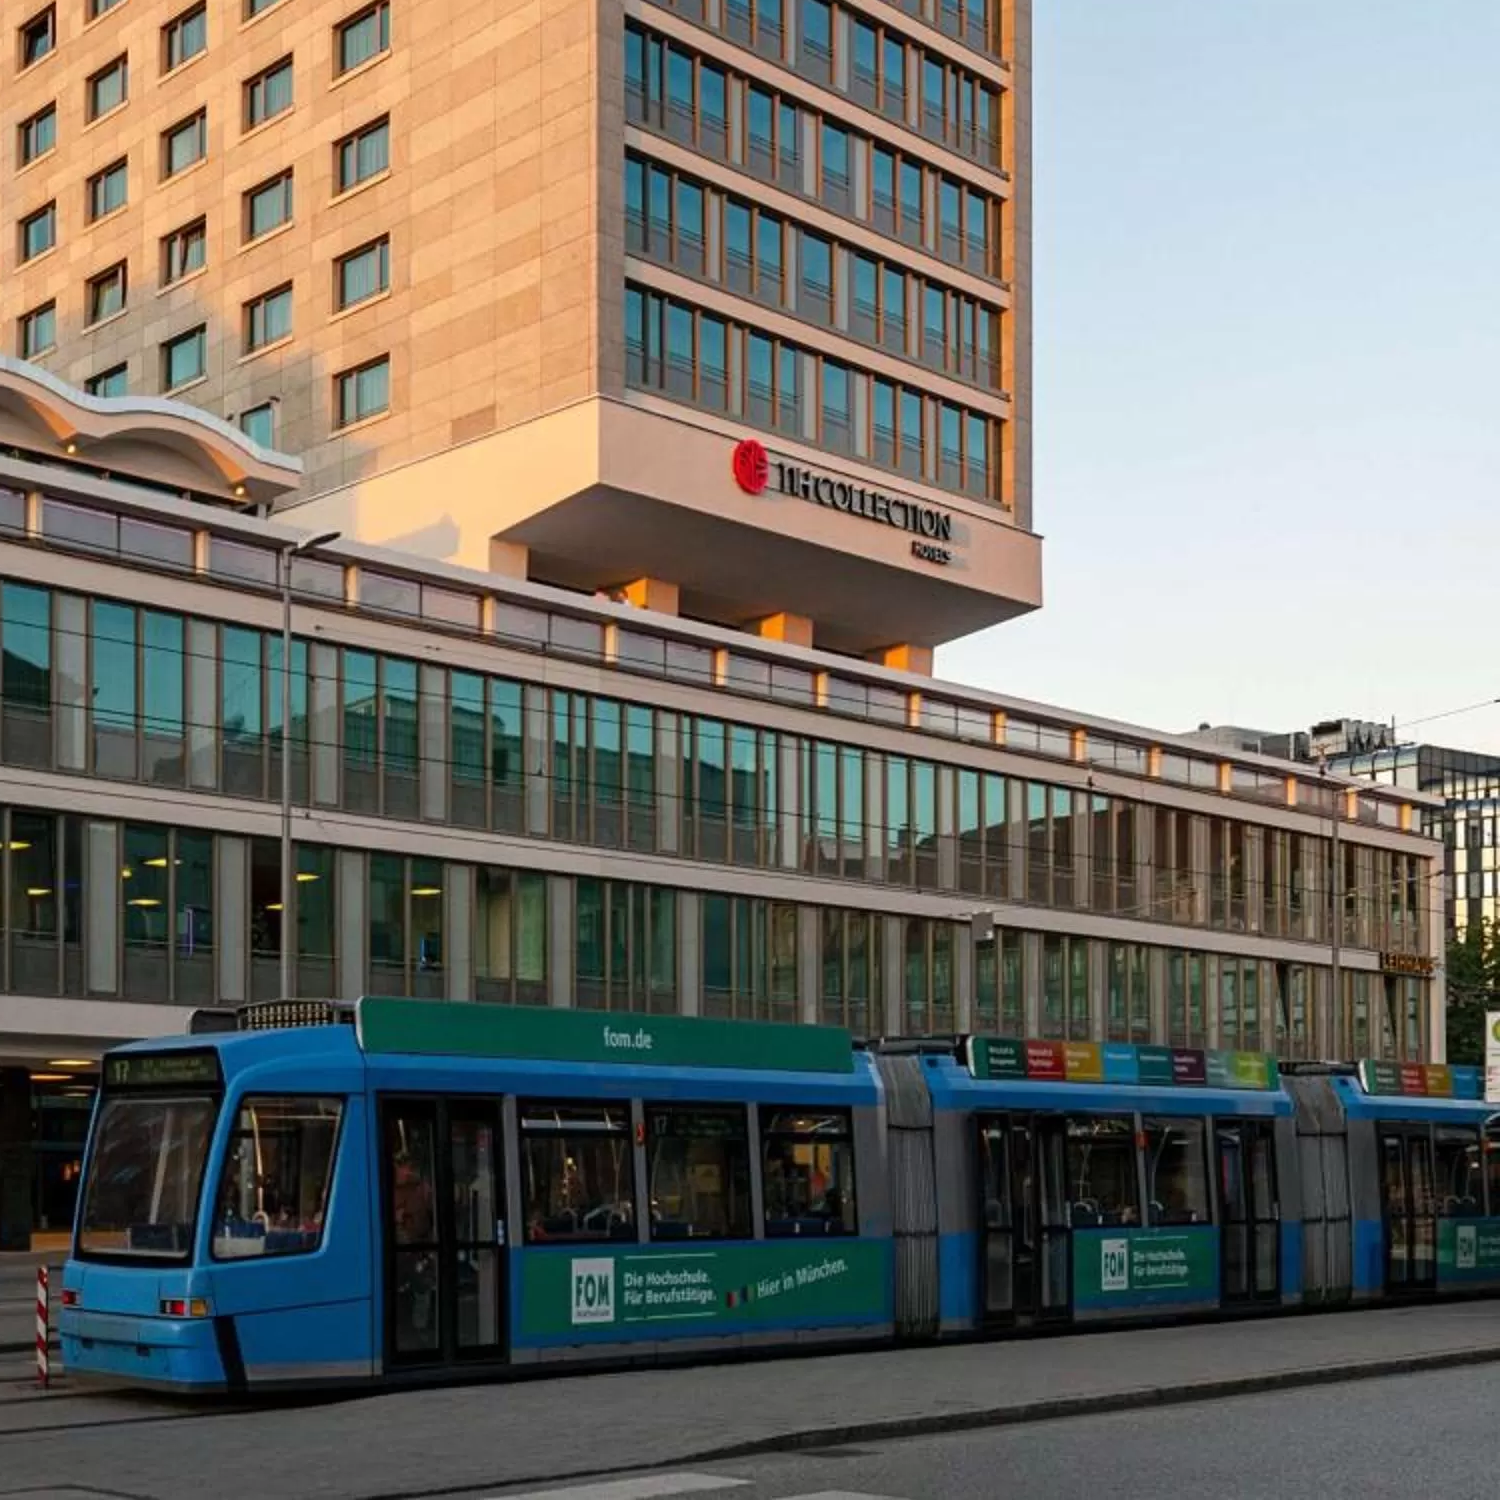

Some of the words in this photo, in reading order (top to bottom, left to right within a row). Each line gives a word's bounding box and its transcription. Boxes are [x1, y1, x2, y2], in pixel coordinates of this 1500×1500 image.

[812, 474, 951, 541] COLLECTION
[603, 1025, 652, 1049] fom.de
[1103, 1252, 1125, 1277] FOM
[575, 1273, 610, 1307] FOM
[623, 1270, 644, 1287] Die
[645, 1268, 712, 1285] Hochschule.
[757, 1277, 781, 1299] Hier
[781, 1271, 795, 1290] in
[795, 1257, 849, 1285] München.
[623, 1288, 644, 1304] Für
